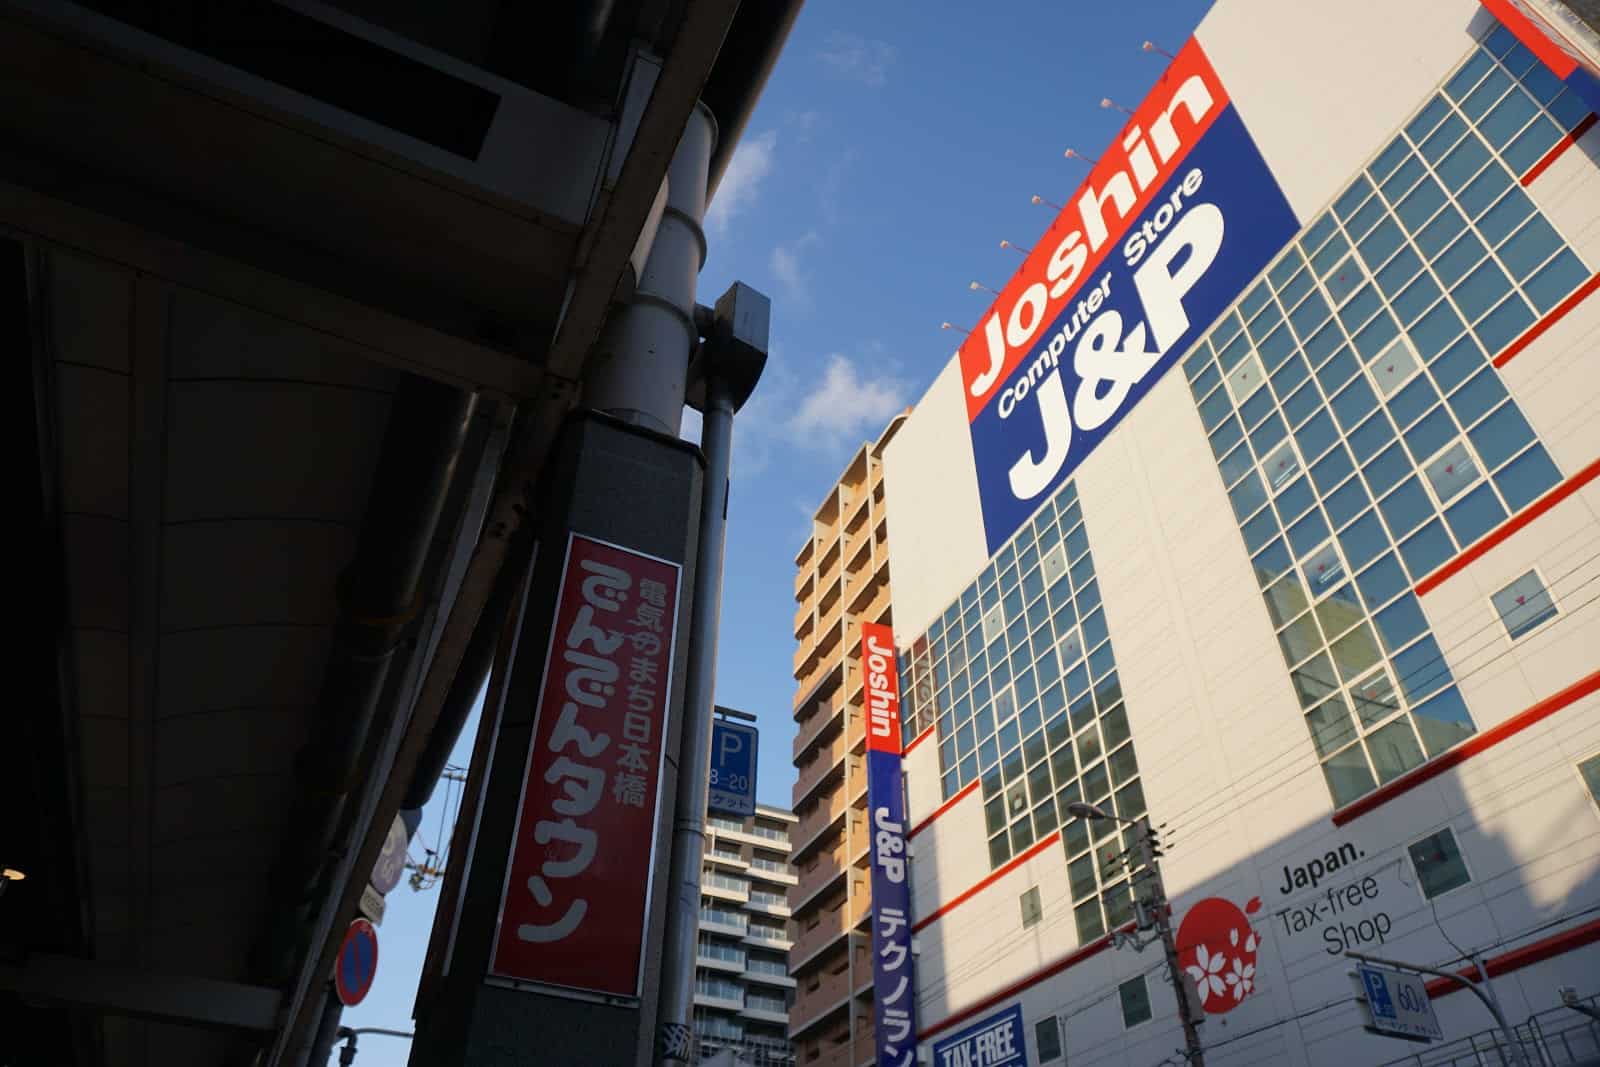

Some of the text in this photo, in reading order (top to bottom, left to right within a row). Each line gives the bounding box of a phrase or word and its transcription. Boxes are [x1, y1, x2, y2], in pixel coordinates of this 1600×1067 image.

[971, 75, 1214, 398] Joshin
[998, 168, 1204, 419] Computer Store
[1008, 203, 1225, 500] J&P
[611, 578, 667, 809] 電気のまち日本橋
[867, 634, 897, 737] Joshin
[517, 558, 632, 944] でんでんタウン
[719, 731, 743, 768] P
[874, 807, 905, 884] J&P
[1279, 841, 1366, 895] Japan.
[1276, 875, 1380, 937] Tax-free
[1324, 910, 1392, 956] Shop
[1369, 973, 1382, 998] P
[942, 1021, 1016, 1067] TAX-FREE
